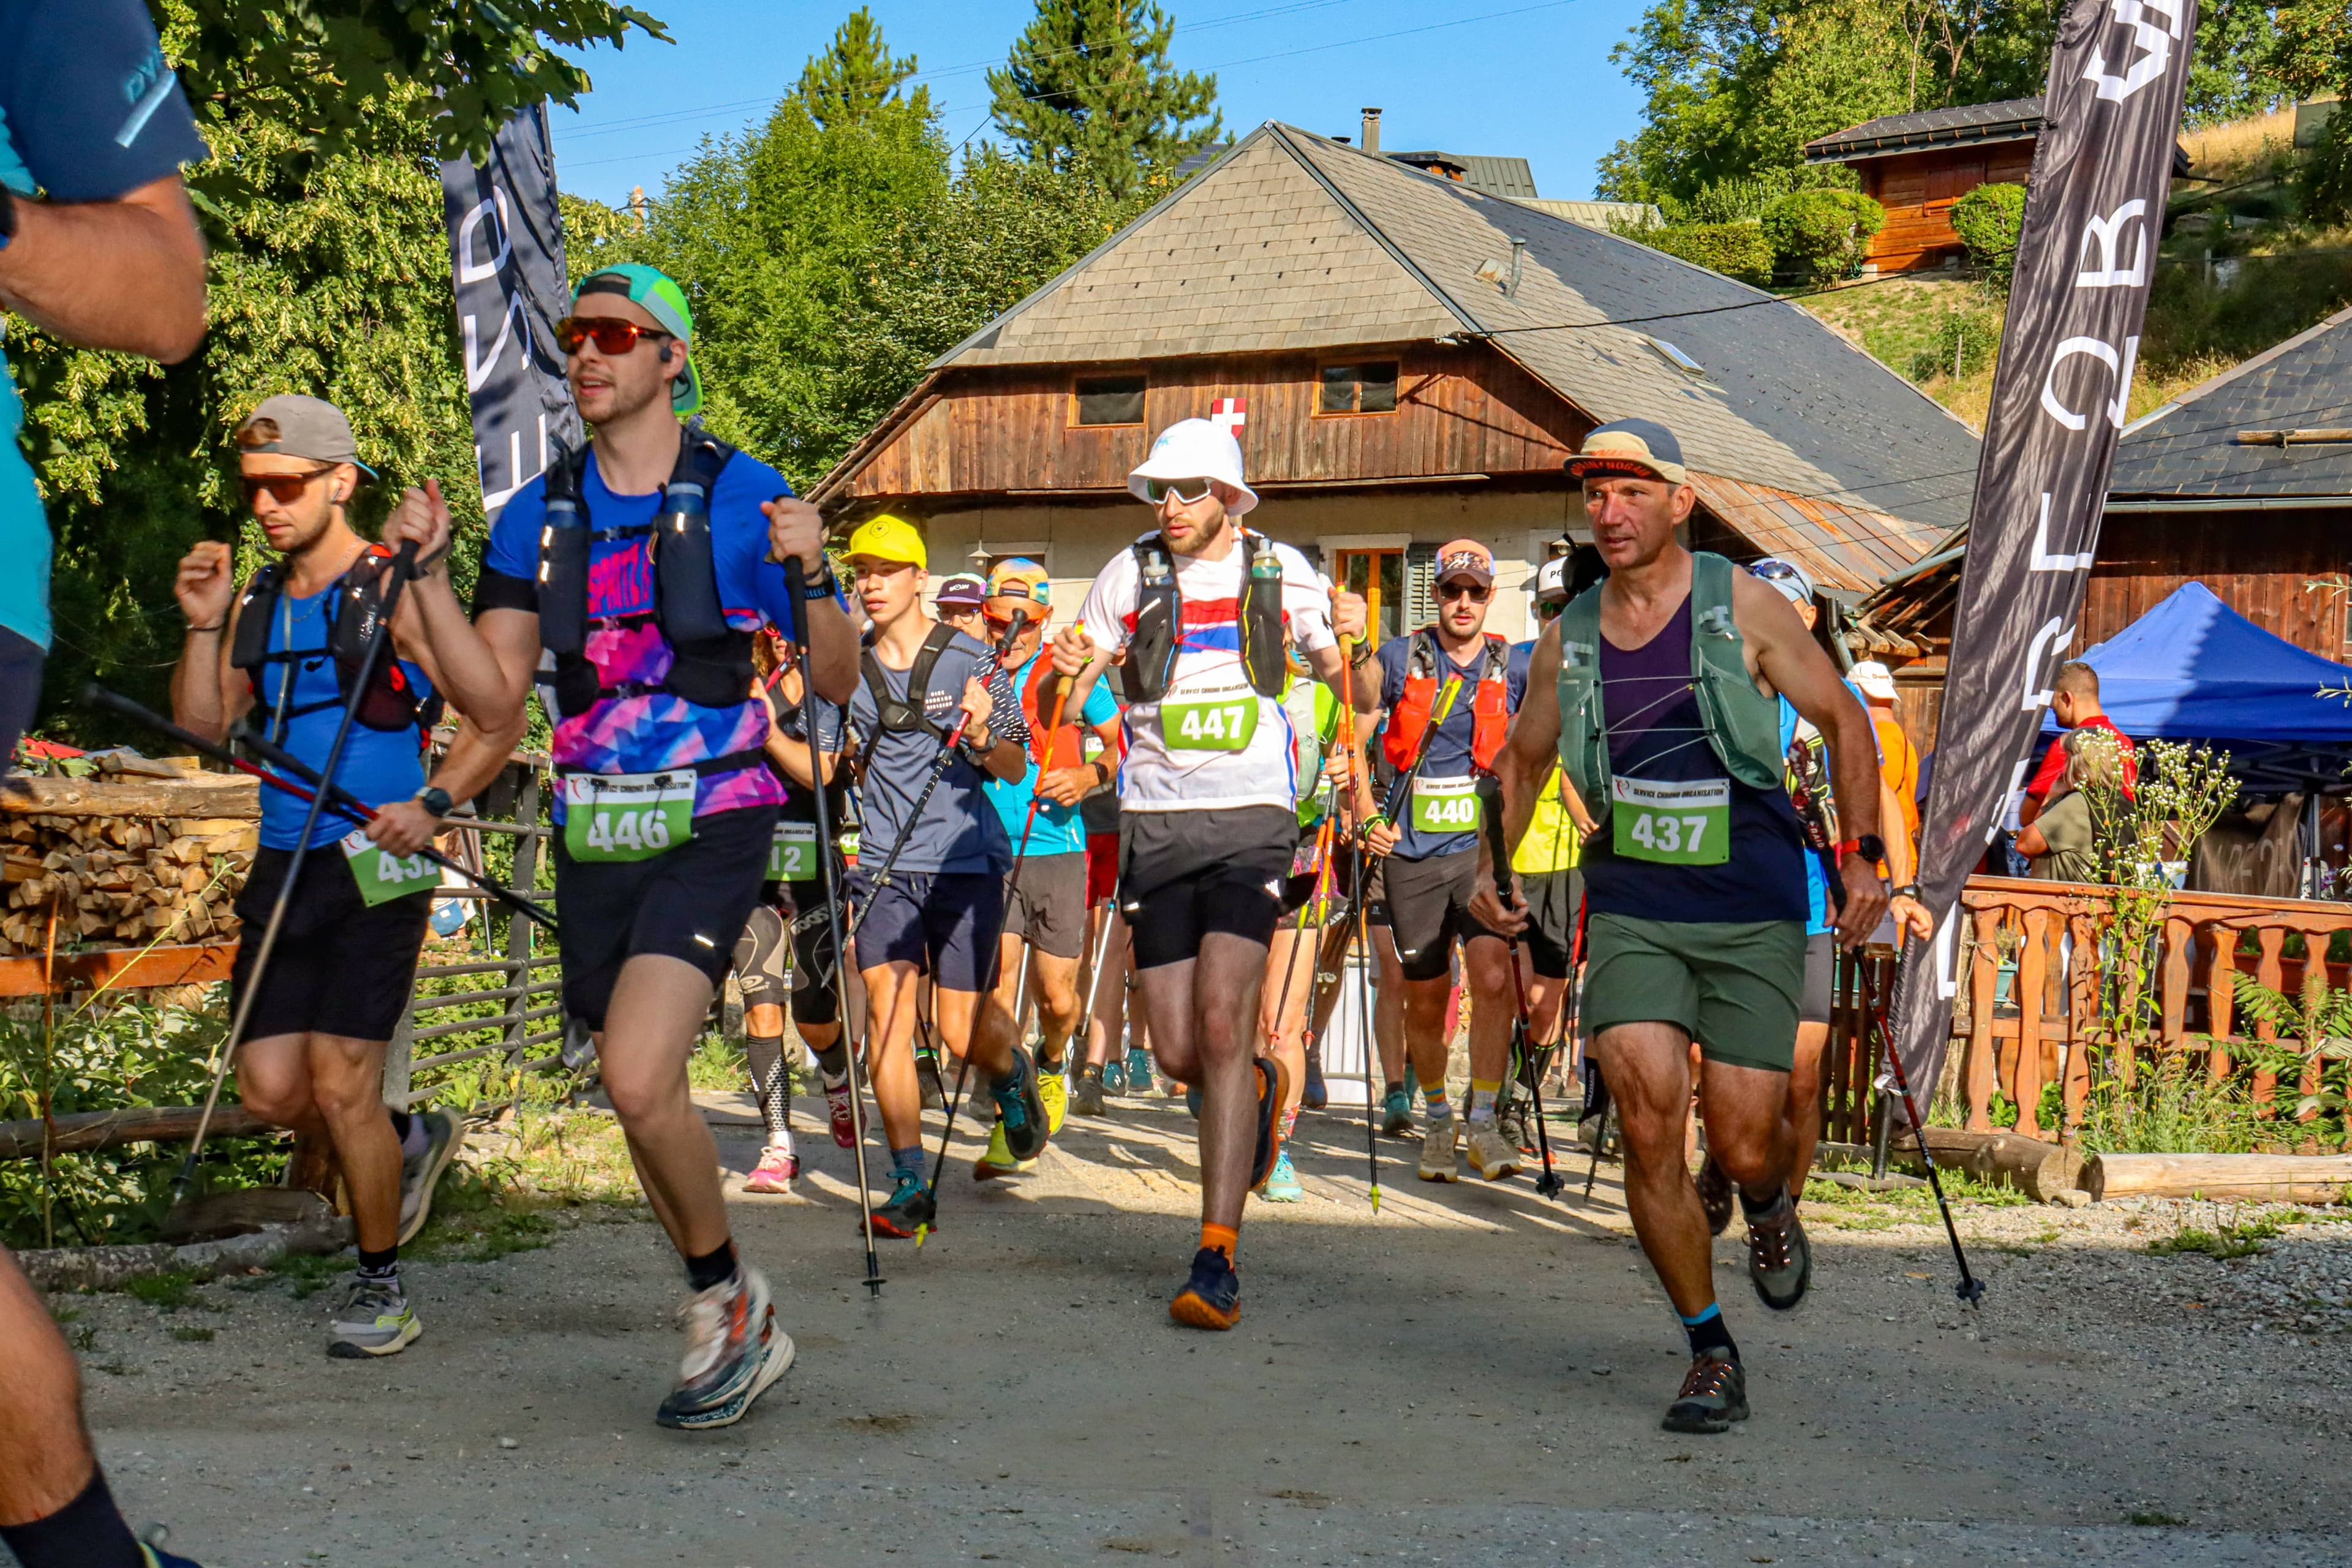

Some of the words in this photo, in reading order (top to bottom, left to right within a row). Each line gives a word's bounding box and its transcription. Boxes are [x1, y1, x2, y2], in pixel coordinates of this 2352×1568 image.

[1180, 705, 1245, 741] 447
[1424, 797, 1474, 824] 440
[1633, 788, 1656, 798] SERVICE
[1681, 788, 1724, 798] ORGANISATION
[587, 809, 670, 853] 446
[1631, 813, 1708, 853] 437
